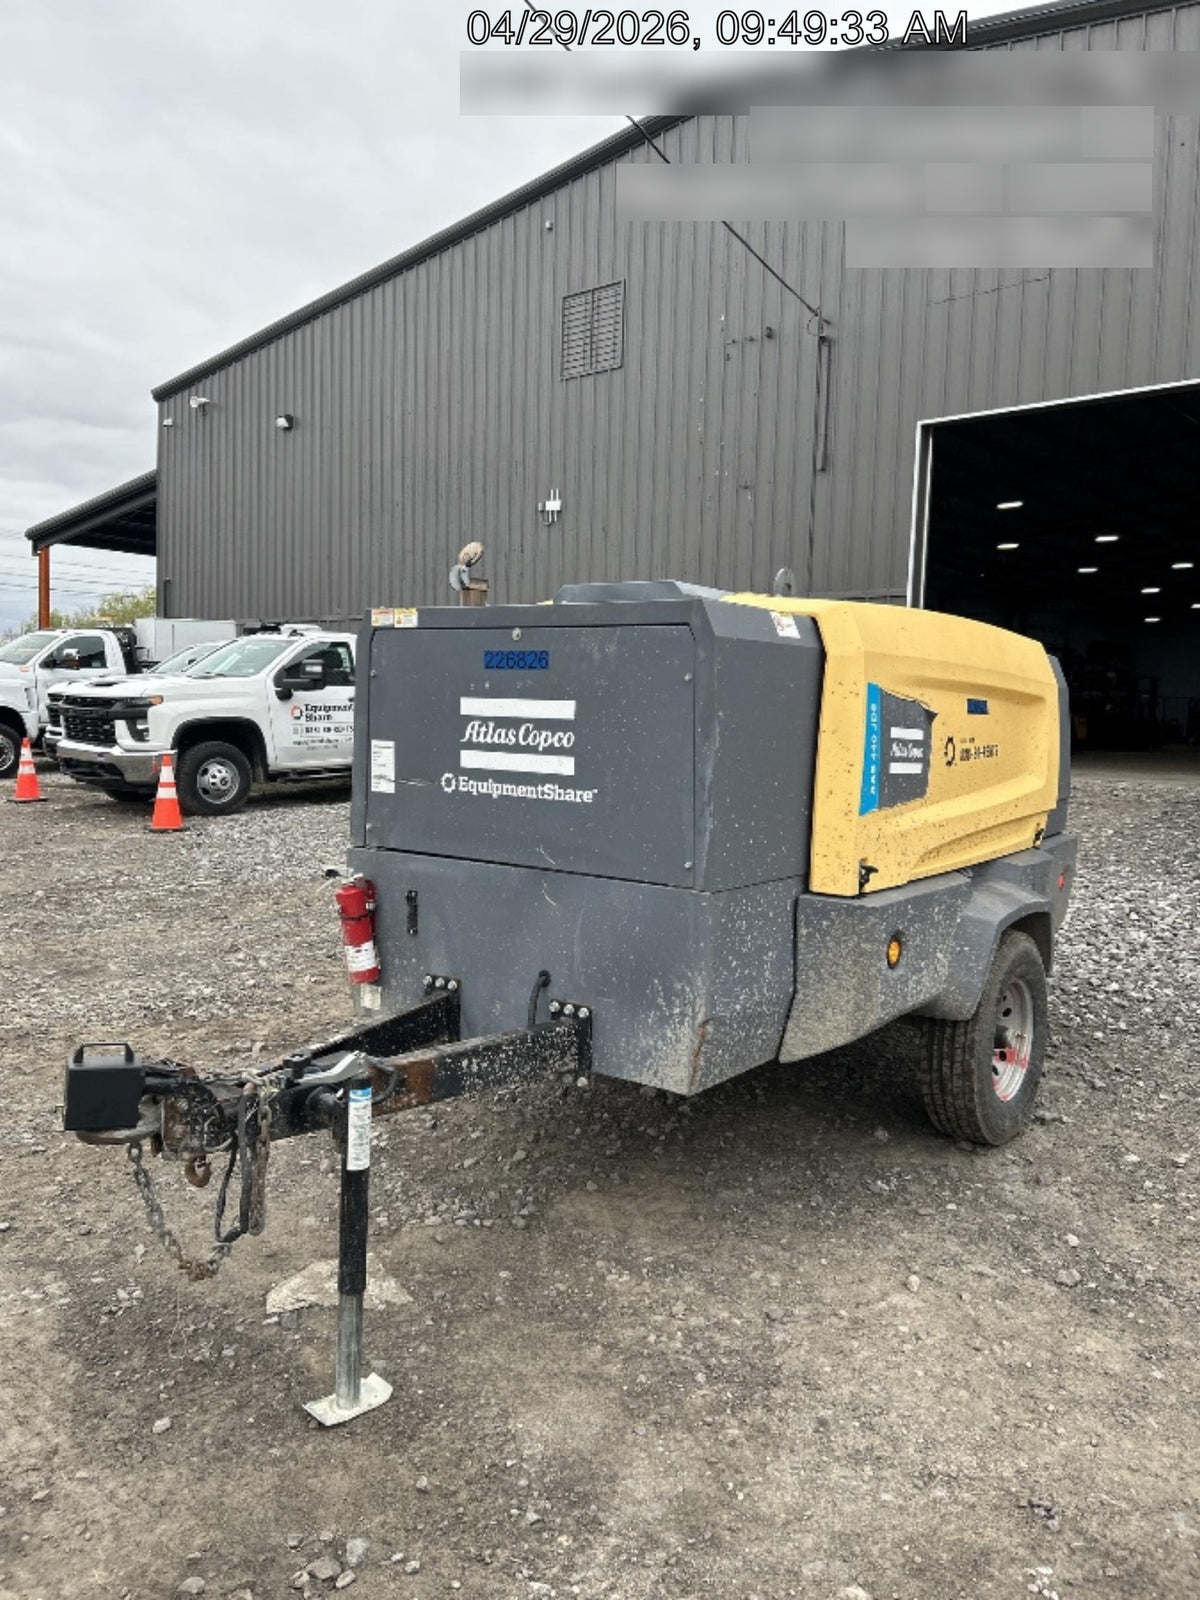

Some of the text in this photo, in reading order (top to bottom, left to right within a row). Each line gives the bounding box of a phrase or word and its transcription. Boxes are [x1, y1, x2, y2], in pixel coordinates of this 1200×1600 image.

[484, 651, 549, 670] 226826
[460, 720, 575, 751] Atlas Copco
[458, 776, 593, 803] EquipmentShare
